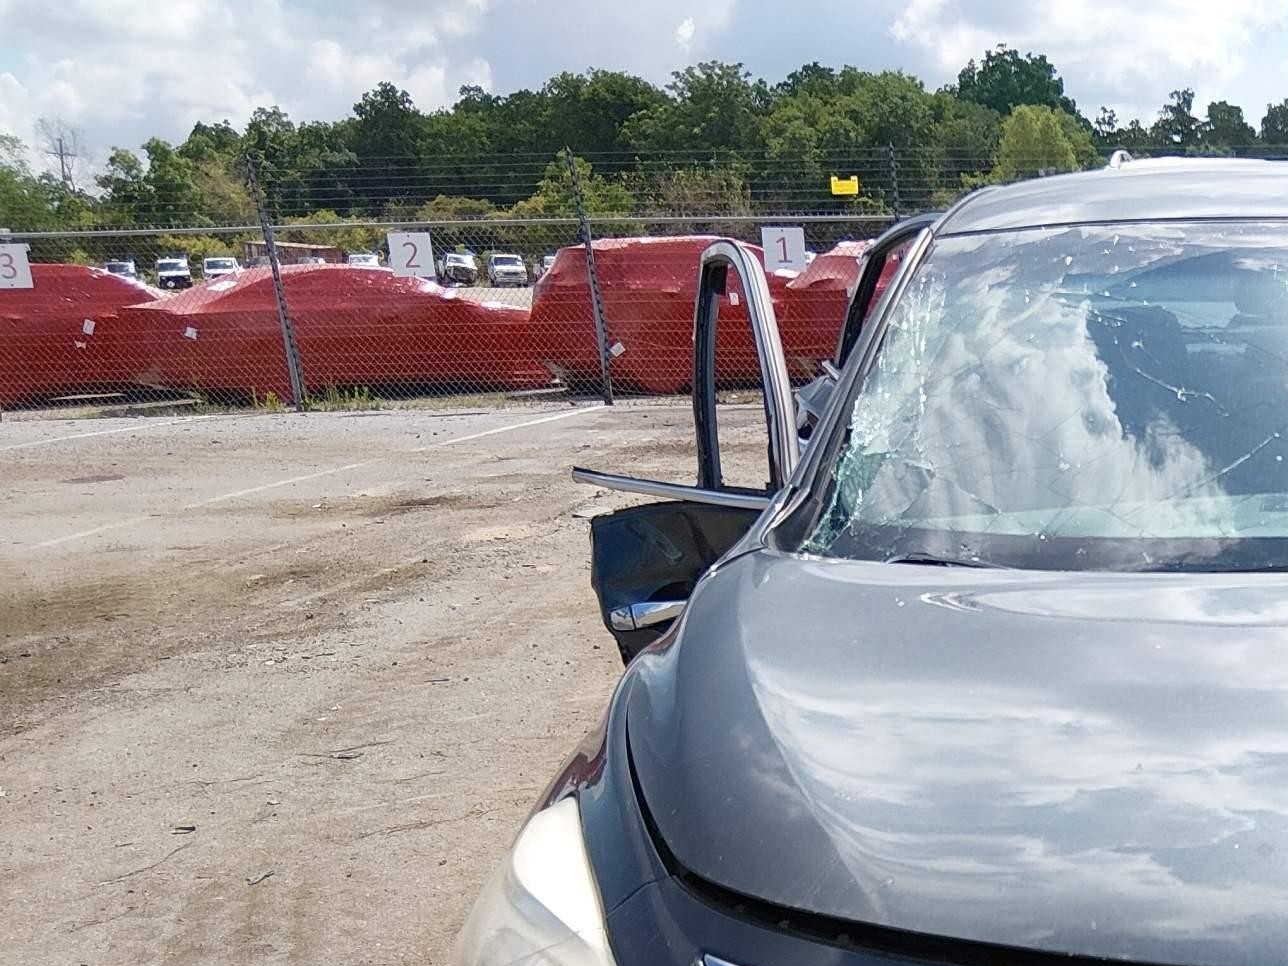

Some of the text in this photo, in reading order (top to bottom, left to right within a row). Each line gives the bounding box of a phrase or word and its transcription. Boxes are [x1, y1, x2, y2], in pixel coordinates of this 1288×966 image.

[402, 241, 421, 269] 2
[775, 236, 793, 264] 1
[0, 253, 18, 280] 3
